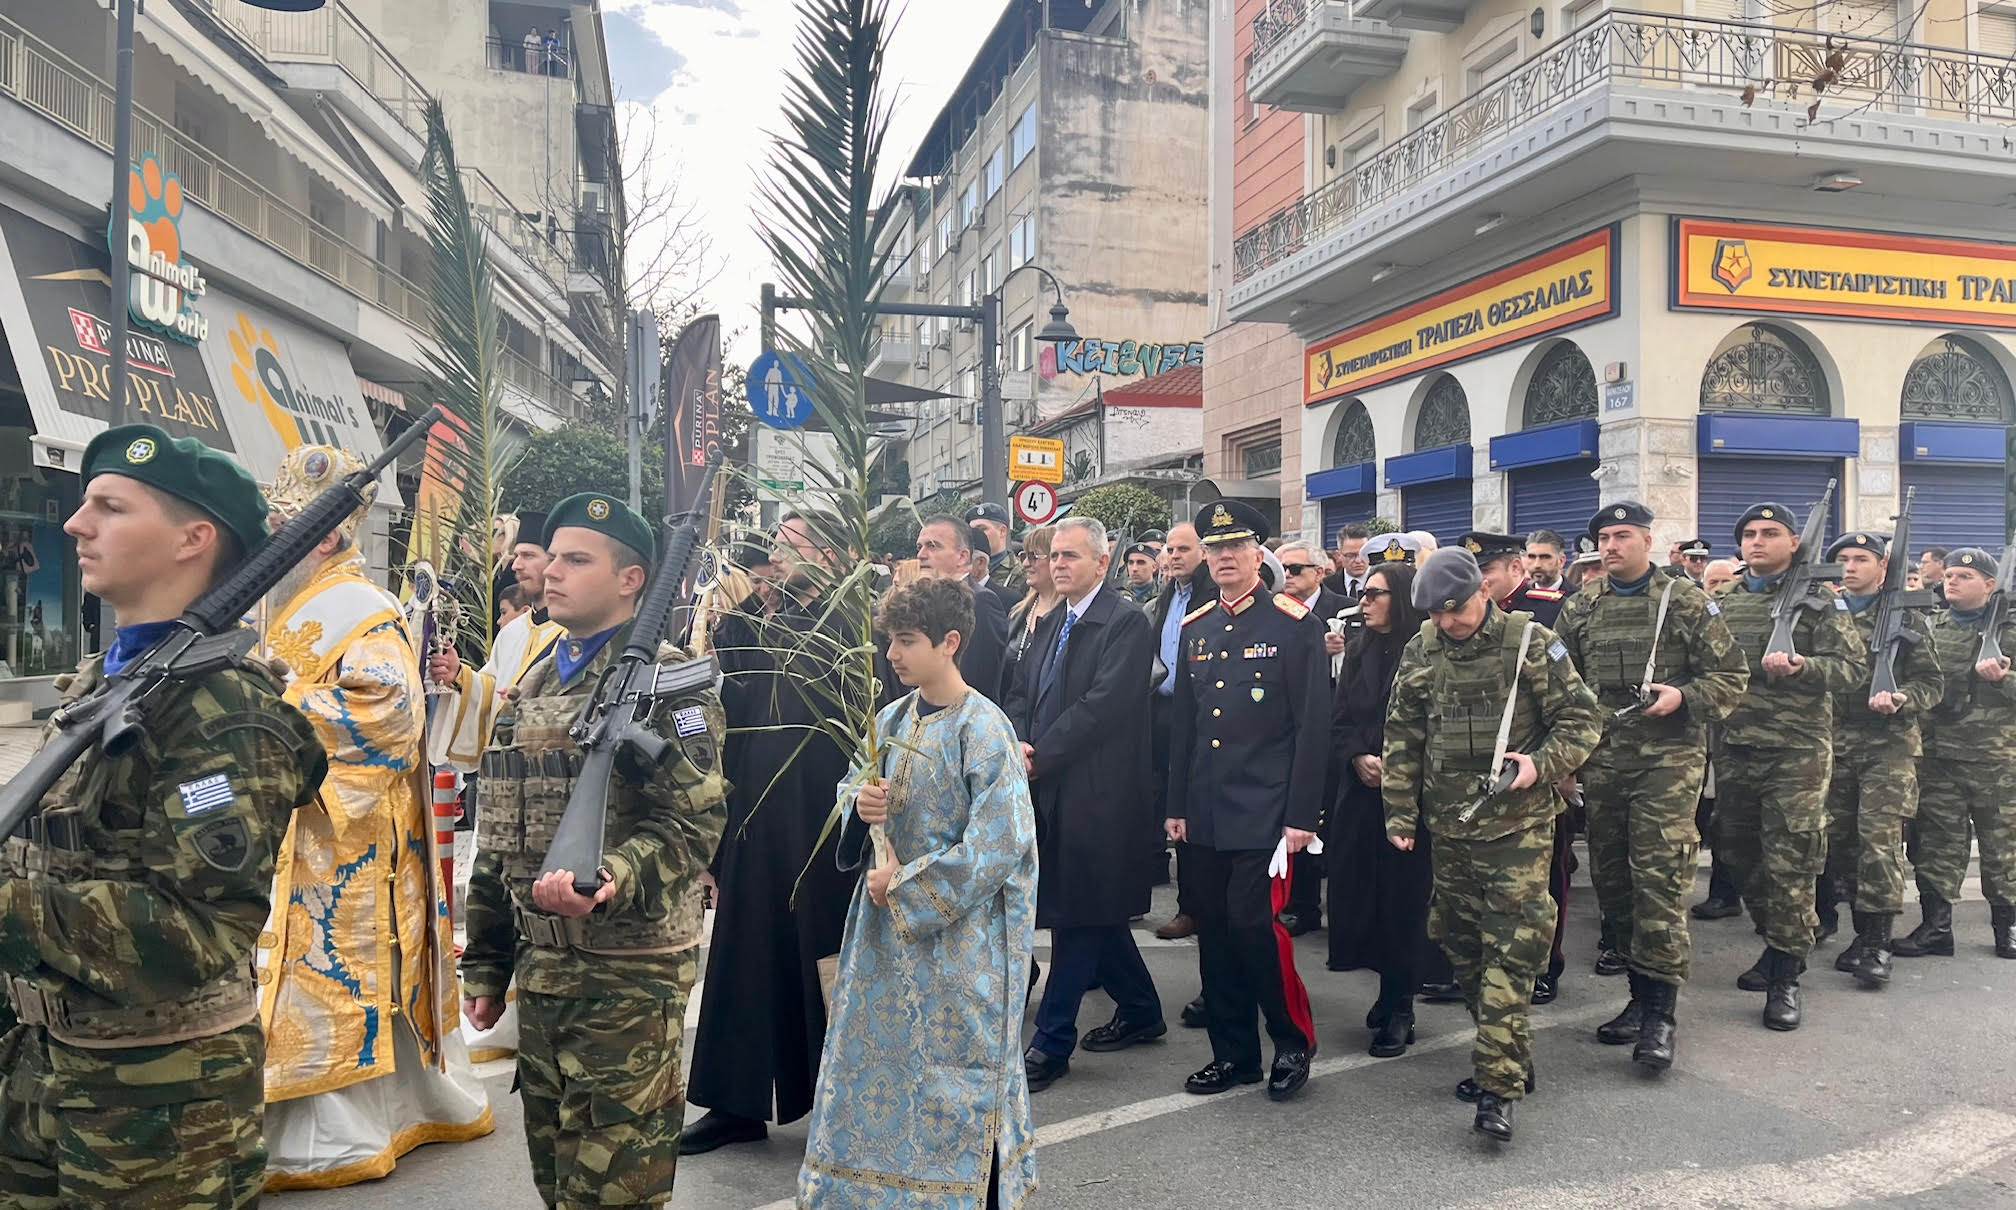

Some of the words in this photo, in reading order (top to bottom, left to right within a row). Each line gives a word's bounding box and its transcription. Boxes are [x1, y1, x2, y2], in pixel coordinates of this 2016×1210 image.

[139, 272, 208, 341] World
[1768, 267, 1947, 299] ΣΥΝΕΤΑΙΡΙΣΤΙΚΗ
[1335, 338, 1412, 378] ΣΥΝΕΤΑΙΡΙΣΤΙΚΗ
[1416, 309, 1484, 350] ΤΡΑΠΕΖΑ
[1487, 269, 1593, 326] ΘΕΣΣΑΛΙΑΣ
[127, 372, 219, 431] PLAN
[694, 394, 704, 448] PURINA
[705, 370, 719, 435] PLAN
[1610, 396, 1628, 409] 167
